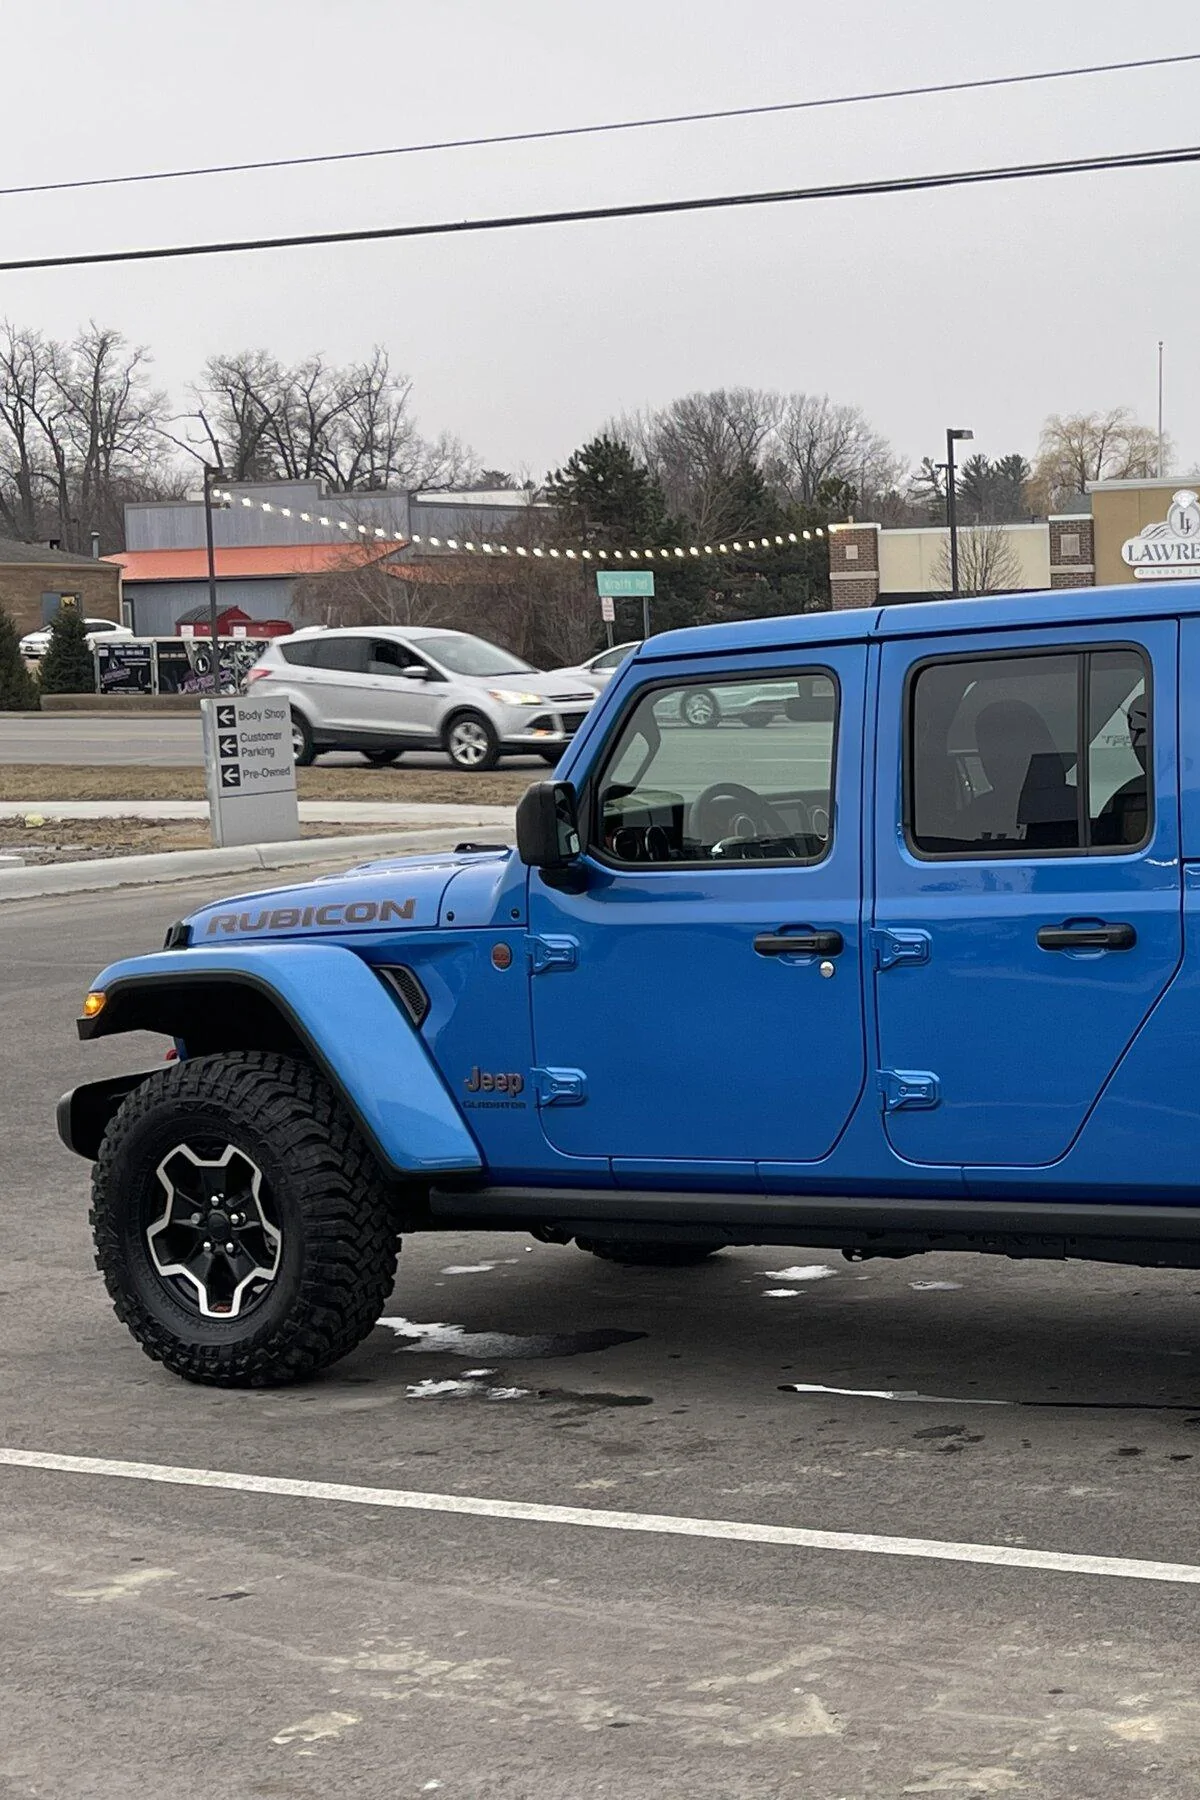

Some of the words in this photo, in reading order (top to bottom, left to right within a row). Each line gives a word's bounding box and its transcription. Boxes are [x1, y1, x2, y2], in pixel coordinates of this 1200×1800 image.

[238, 710, 262, 721] Body
[264, 708, 287, 720] Shop
[240, 732, 282, 743] Customer
[241, 746, 275, 758] Parking
[242, 767, 291, 779] Pre-Owned
[206, 898, 417, 935] RUBICON
[464, 1065, 525, 1097] Jeep
